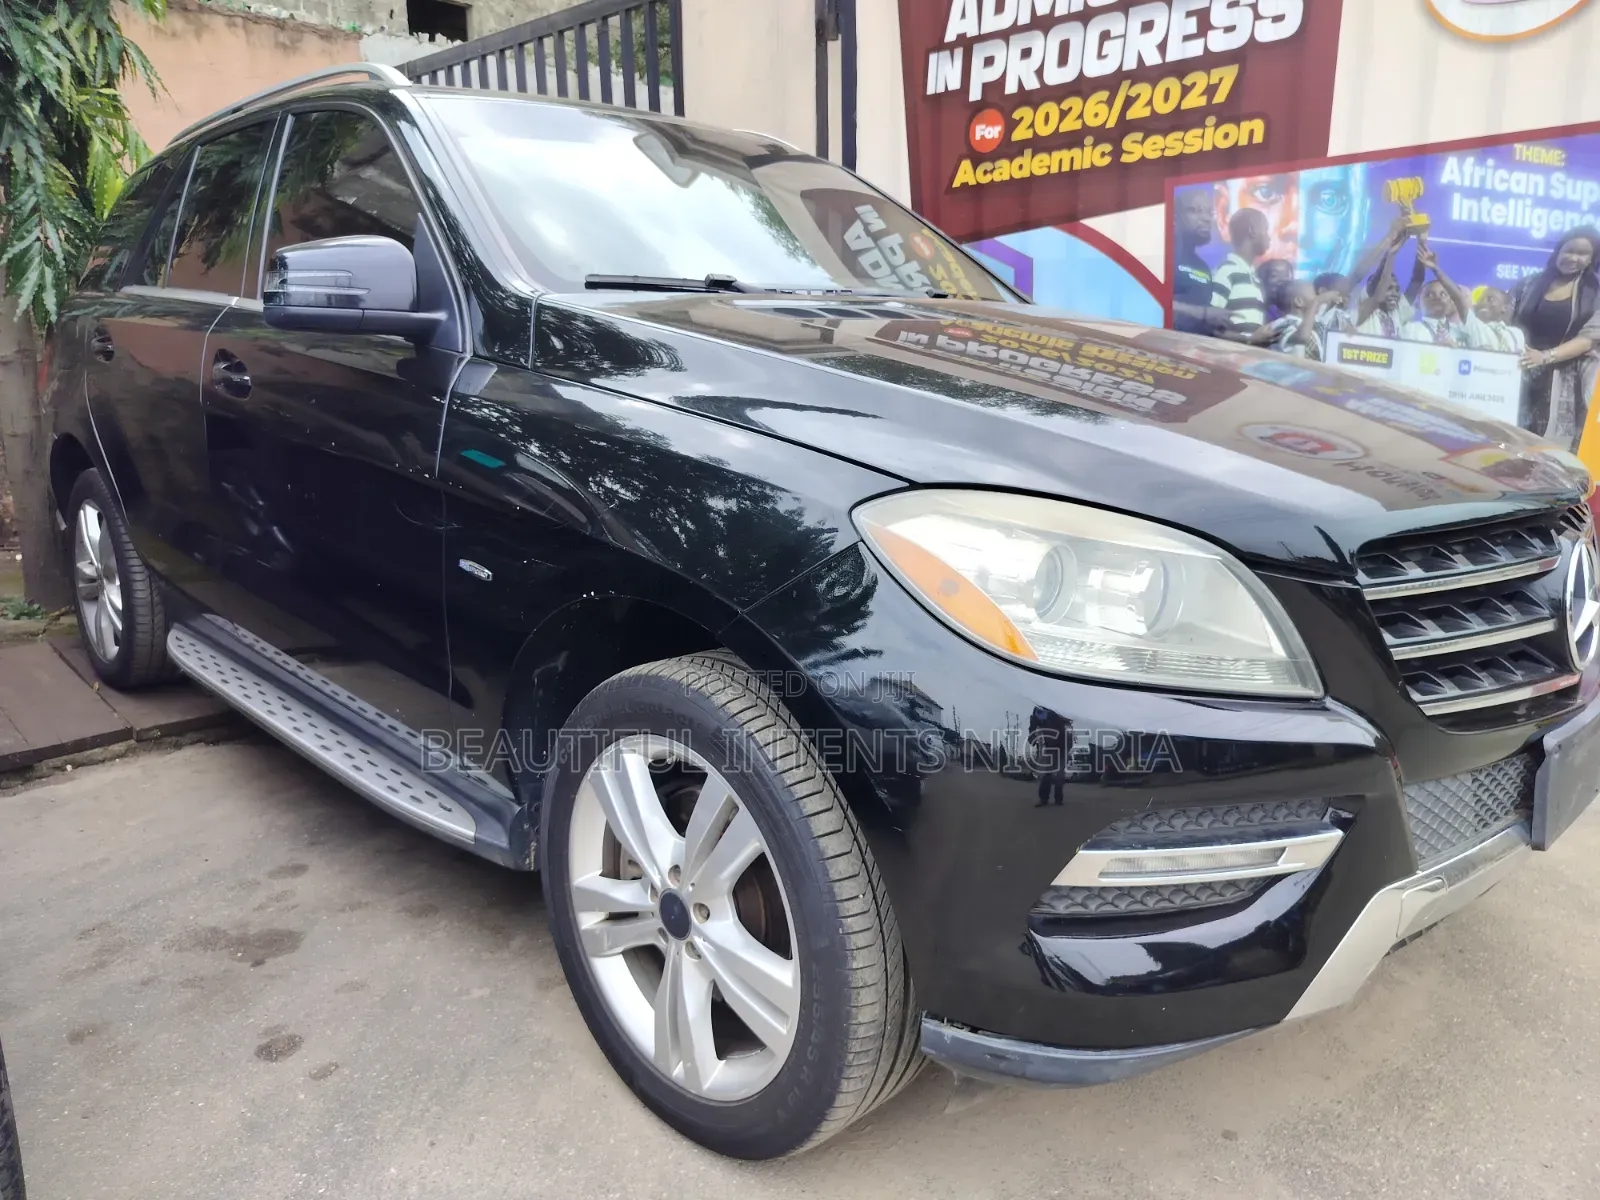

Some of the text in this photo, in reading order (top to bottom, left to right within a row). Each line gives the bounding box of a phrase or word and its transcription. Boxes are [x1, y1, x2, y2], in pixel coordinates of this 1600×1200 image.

[926, 0, 1304, 103] IN PROGRESS
[975, 64, 1240, 142] For 2026/2027
[952, 115, 1266, 189] Academic Session
[1440, 155, 1545, 197] African
[1496, 263, 1519, 280] SEE
[1342, 347, 1388, 364] 1ST PRIZE
